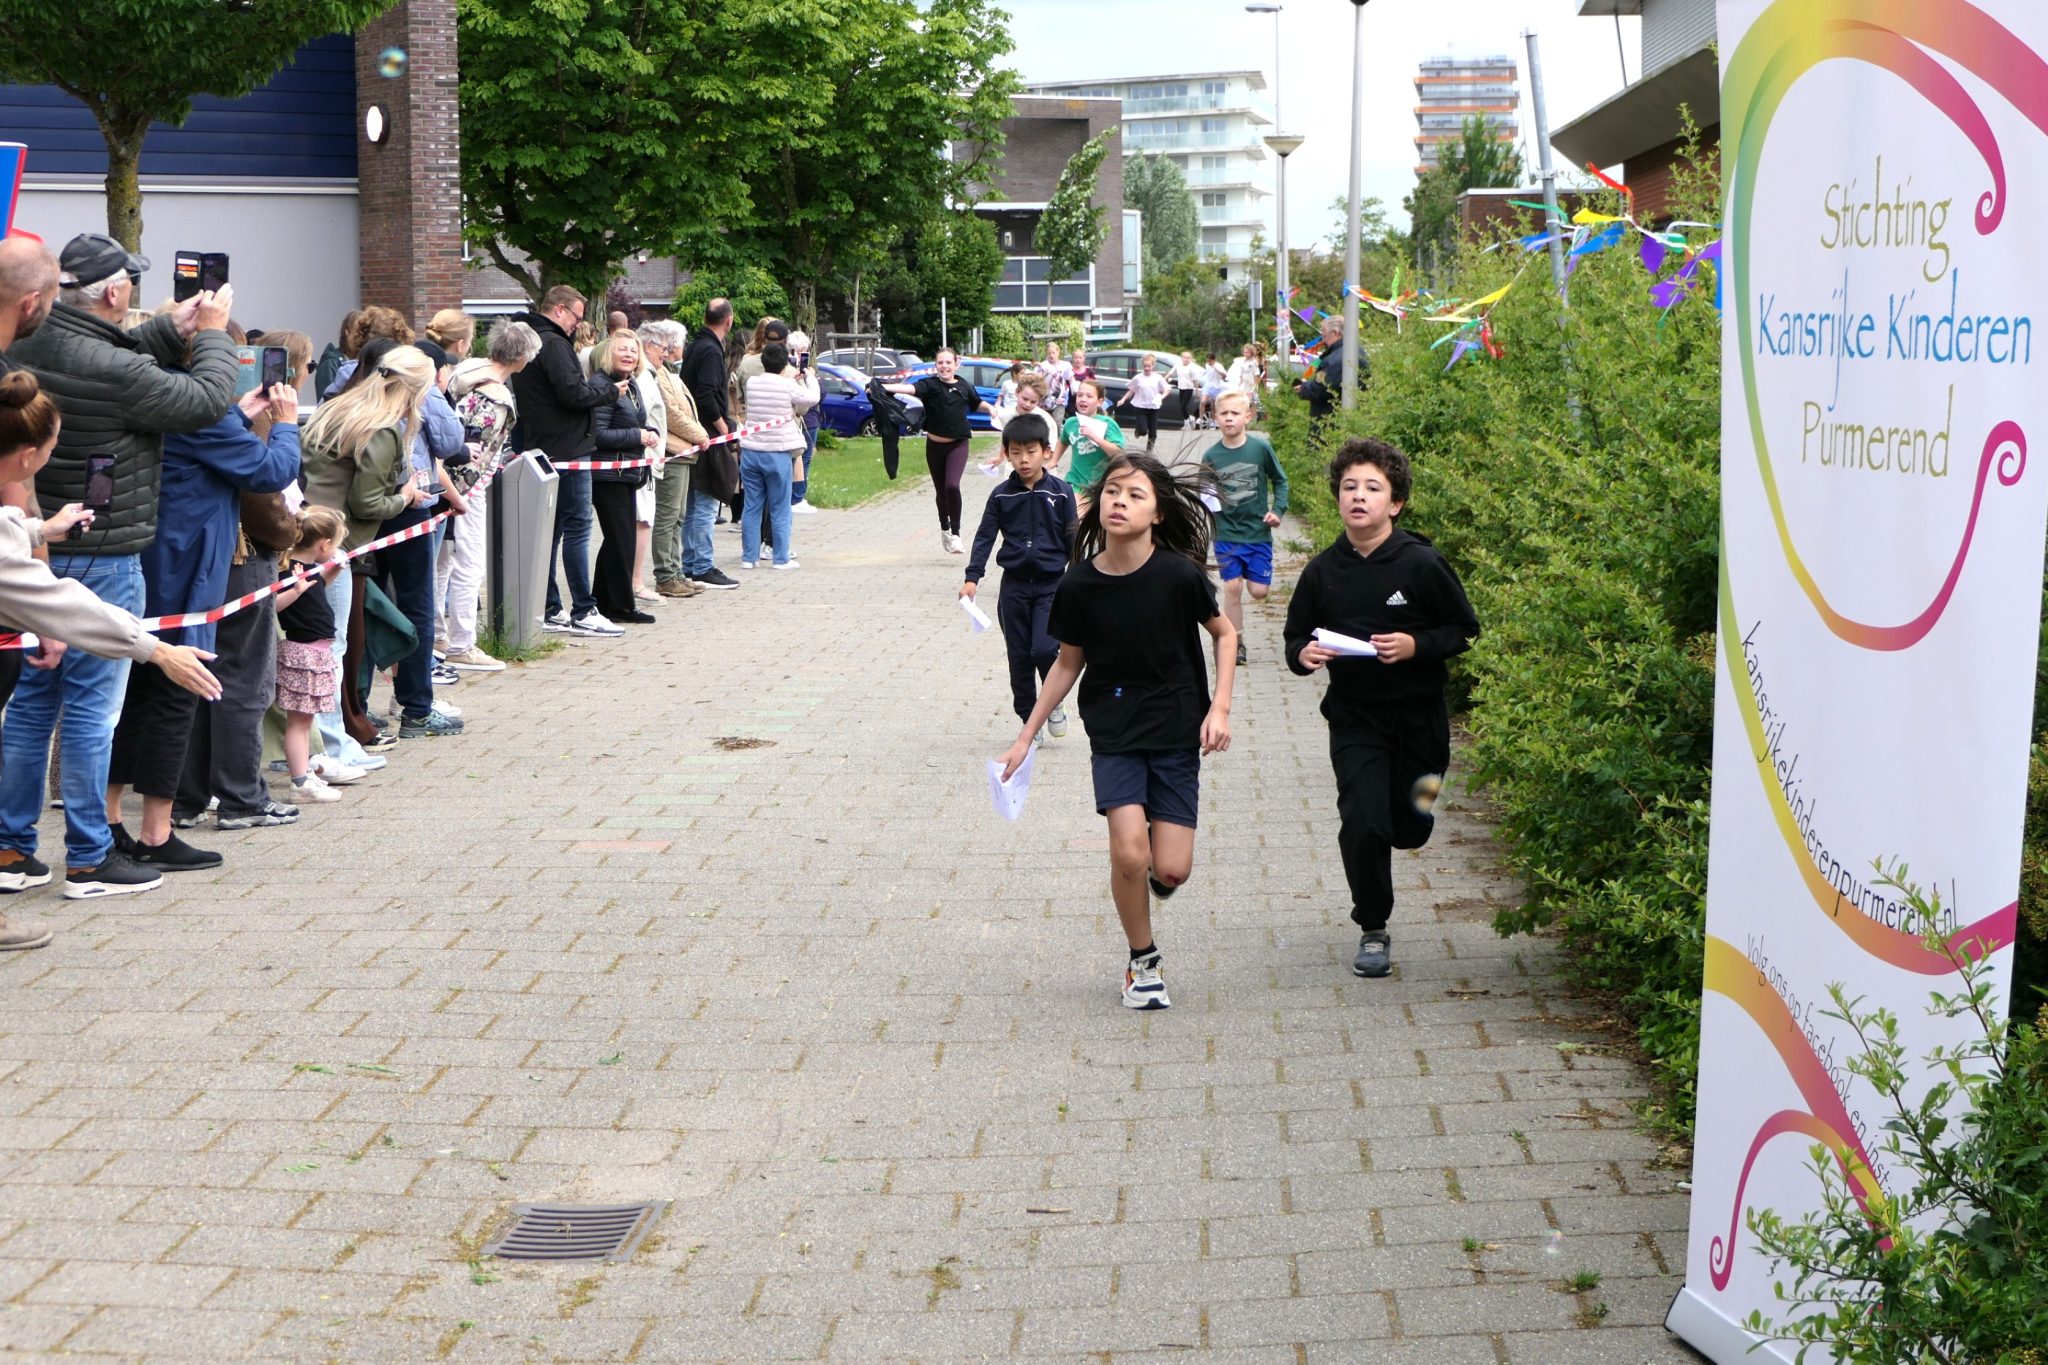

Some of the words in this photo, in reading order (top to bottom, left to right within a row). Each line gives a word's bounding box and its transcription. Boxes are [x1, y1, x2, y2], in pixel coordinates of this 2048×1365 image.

[1820, 154, 1952, 282] Stichting
[1758, 267, 1875, 411] Kansrijke
[1887, 268, 2031, 365] Kinderen
[1802, 384, 1954, 477] Purmerend
[1741, 620, 1958, 937] kansrijkekinderenpurmerennl
[1747, 933, 1769, 987] Volg
[1768, 965, 1788, 999] ons
[1788, 992, 1801, 1033] op
[1802, 1001, 1854, 1112] facebook
[1850, 1109, 1867, 1142] en
